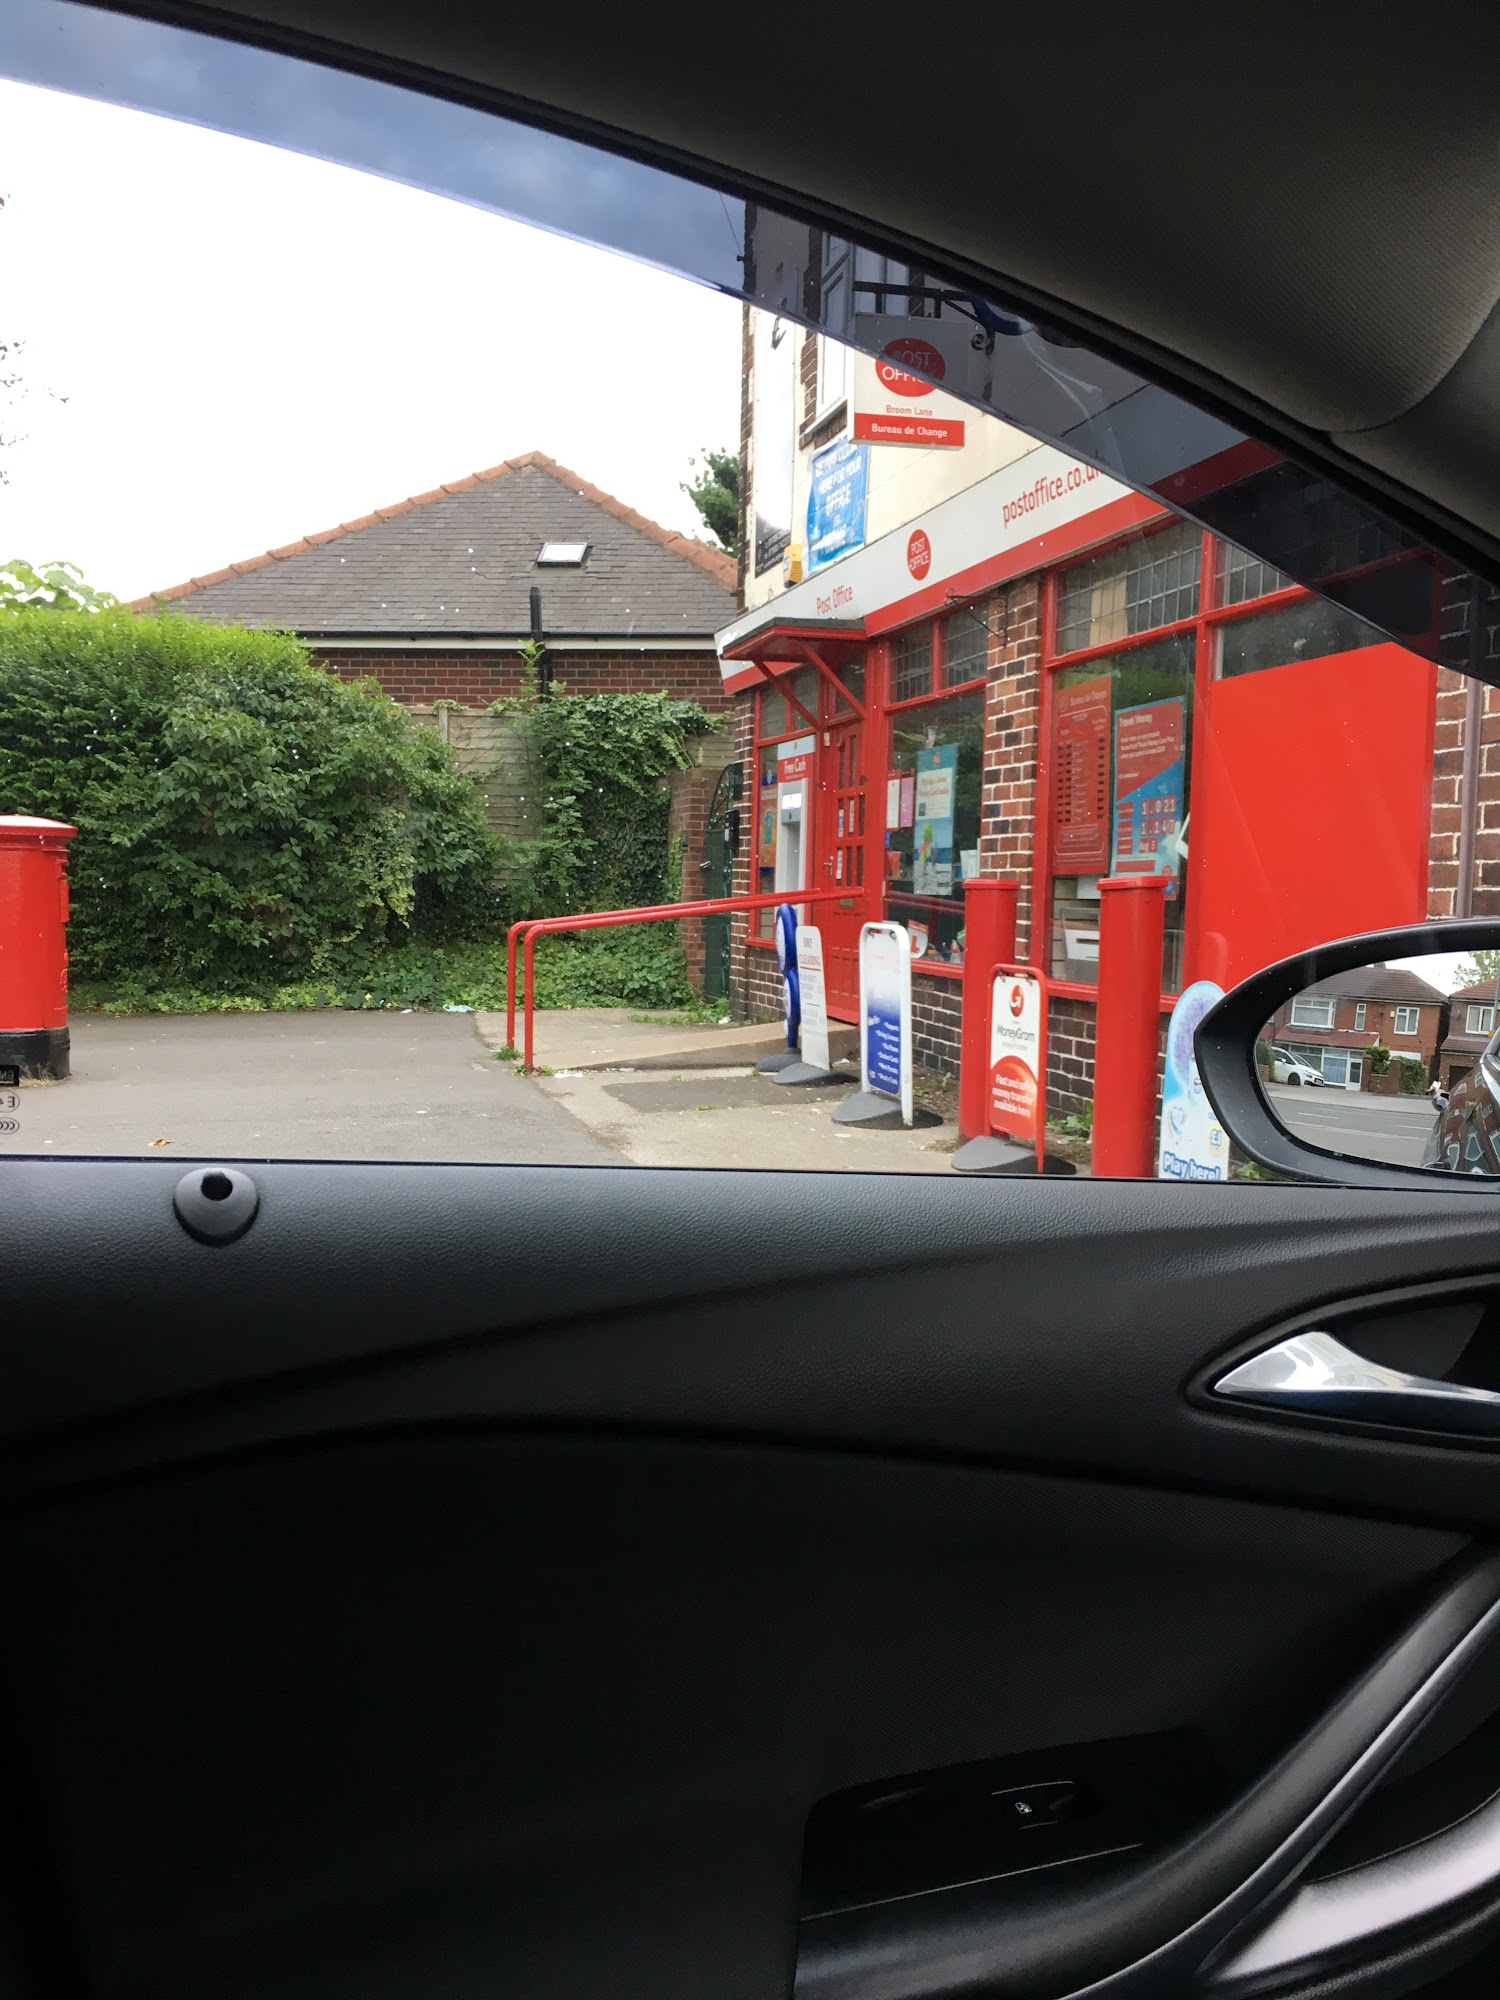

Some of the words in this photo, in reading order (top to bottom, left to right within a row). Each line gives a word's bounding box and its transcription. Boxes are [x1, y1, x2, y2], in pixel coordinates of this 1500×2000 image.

[886, 405, 912, 414] Broom
[914, 407, 933, 416] Lane
[871, 423, 902, 434] Bureau
[904, 426, 915, 435] de
[917, 427, 948, 439] Change
[1002, 464, 1099, 529] postoffice.co.u
[911, 537, 926, 555] POST
[910, 553, 930, 572] OFFICE
[816, 596, 831, 616] Post
[833, 584, 854, 605] Office
[785, 761, 795, 775] Free
[1163, 1150, 1188, 1179] Play
[1188, 1158, 1221, 1181] here!
